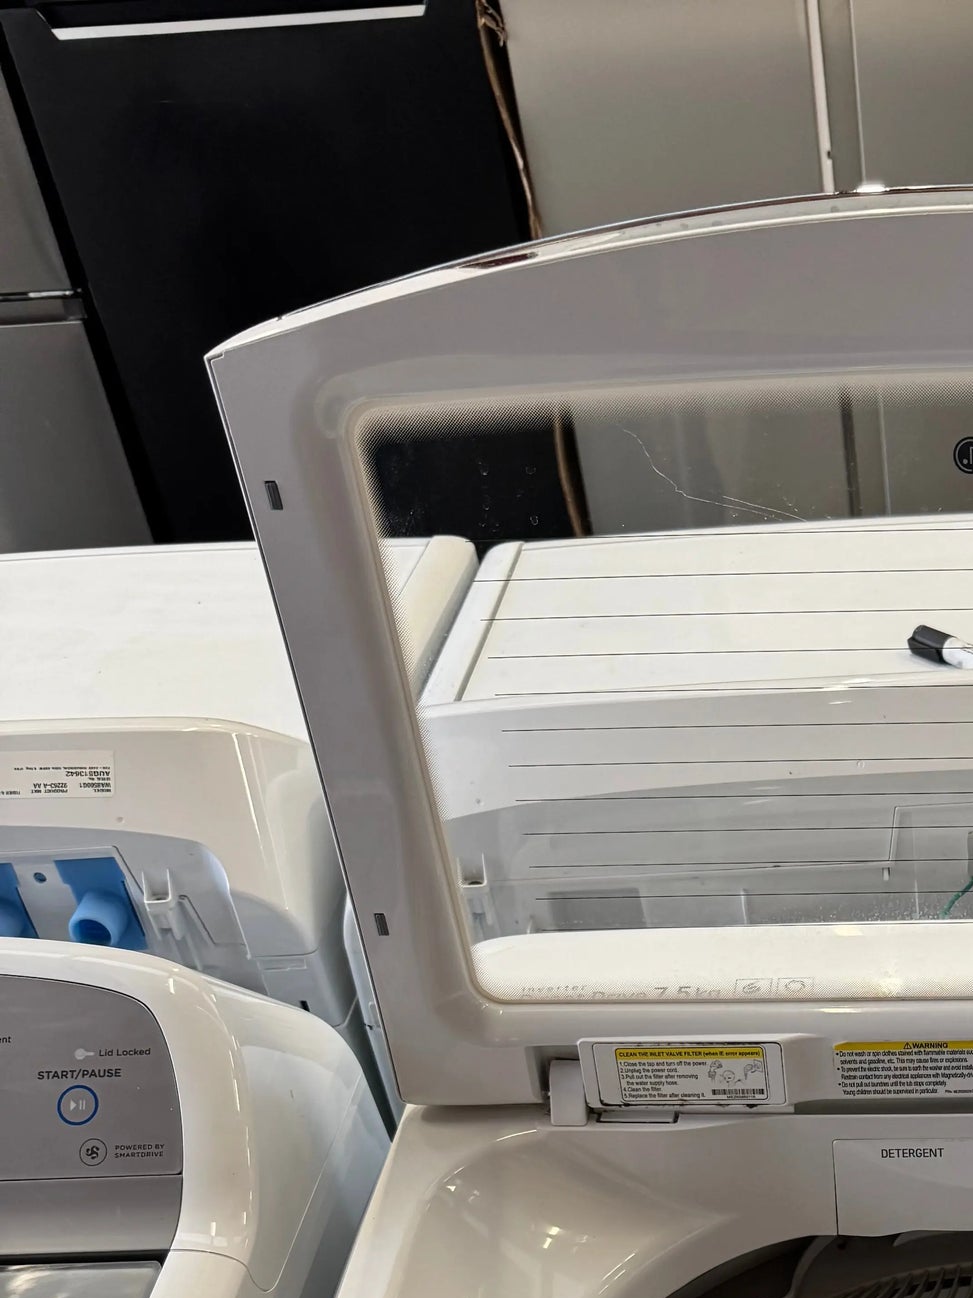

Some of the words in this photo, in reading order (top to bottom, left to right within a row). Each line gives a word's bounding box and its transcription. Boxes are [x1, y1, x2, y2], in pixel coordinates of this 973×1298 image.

[99, 1049, 113, 1057] Lid
[117, 1048, 151, 1056] Locked
[37, 1068, 122, 1080] START/PAUSE
[881, 1147, 945, 1158] DETERGENT
